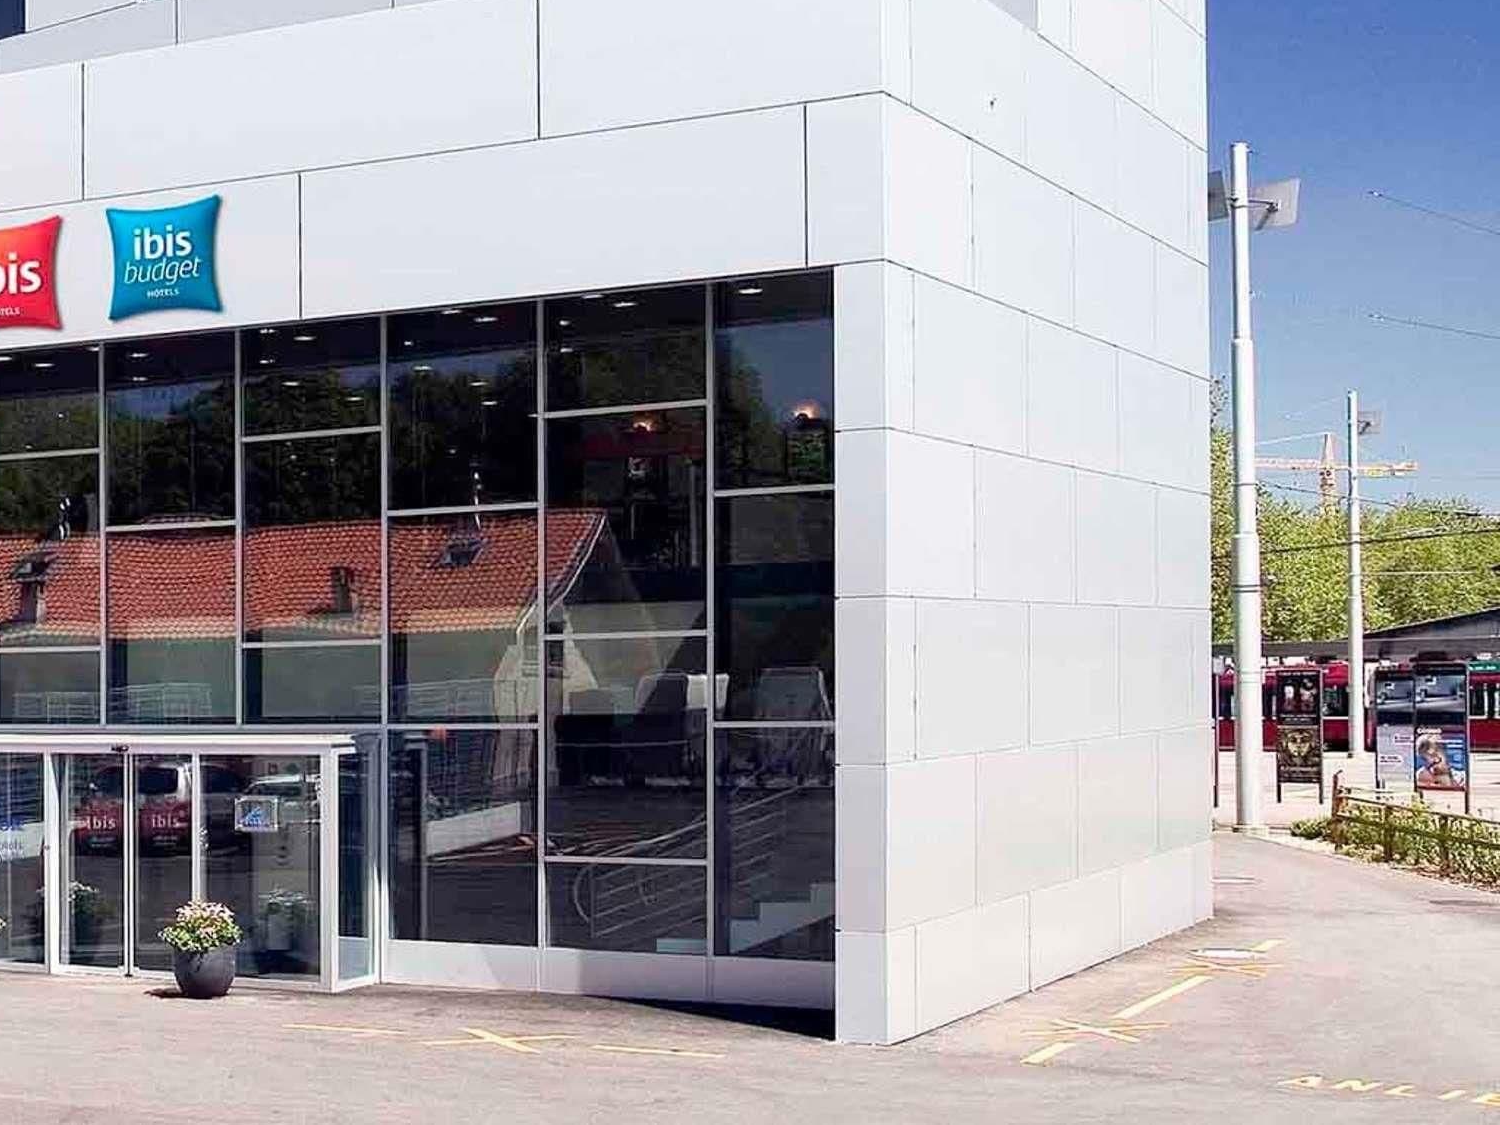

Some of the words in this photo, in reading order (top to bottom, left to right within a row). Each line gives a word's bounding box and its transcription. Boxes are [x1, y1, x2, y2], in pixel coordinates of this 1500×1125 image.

[133, 224, 192, 260] ibis
[124, 256, 202, 286] budget
[147, 288, 180, 298] HOTELS
[86, 815, 117, 830] ibis
[152, 814, 179, 829] ibis
